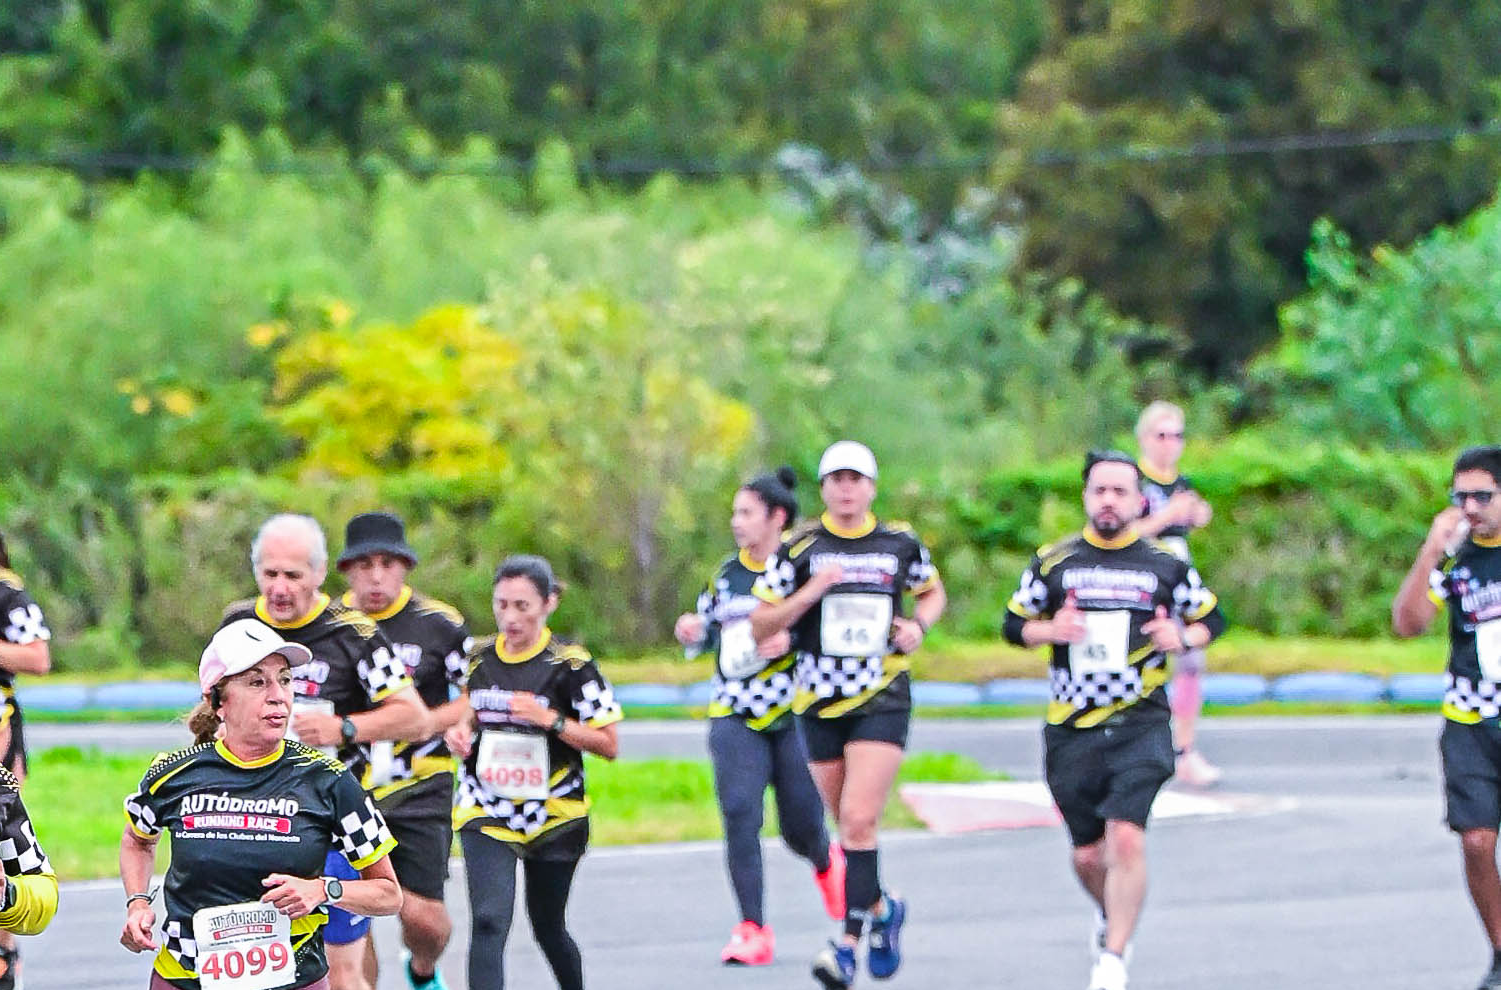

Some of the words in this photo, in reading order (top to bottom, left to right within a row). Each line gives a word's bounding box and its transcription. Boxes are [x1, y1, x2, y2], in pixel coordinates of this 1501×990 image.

[481, 766, 543, 788] 4098
[180, 792, 299, 817] AUTÓDROMO
[194, 815, 244, 829] RUNNING
[248, 816, 278, 831] RACE
[209, 909, 277, 932] AUTÓDROMO
[201, 940, 289, 980] 4099
